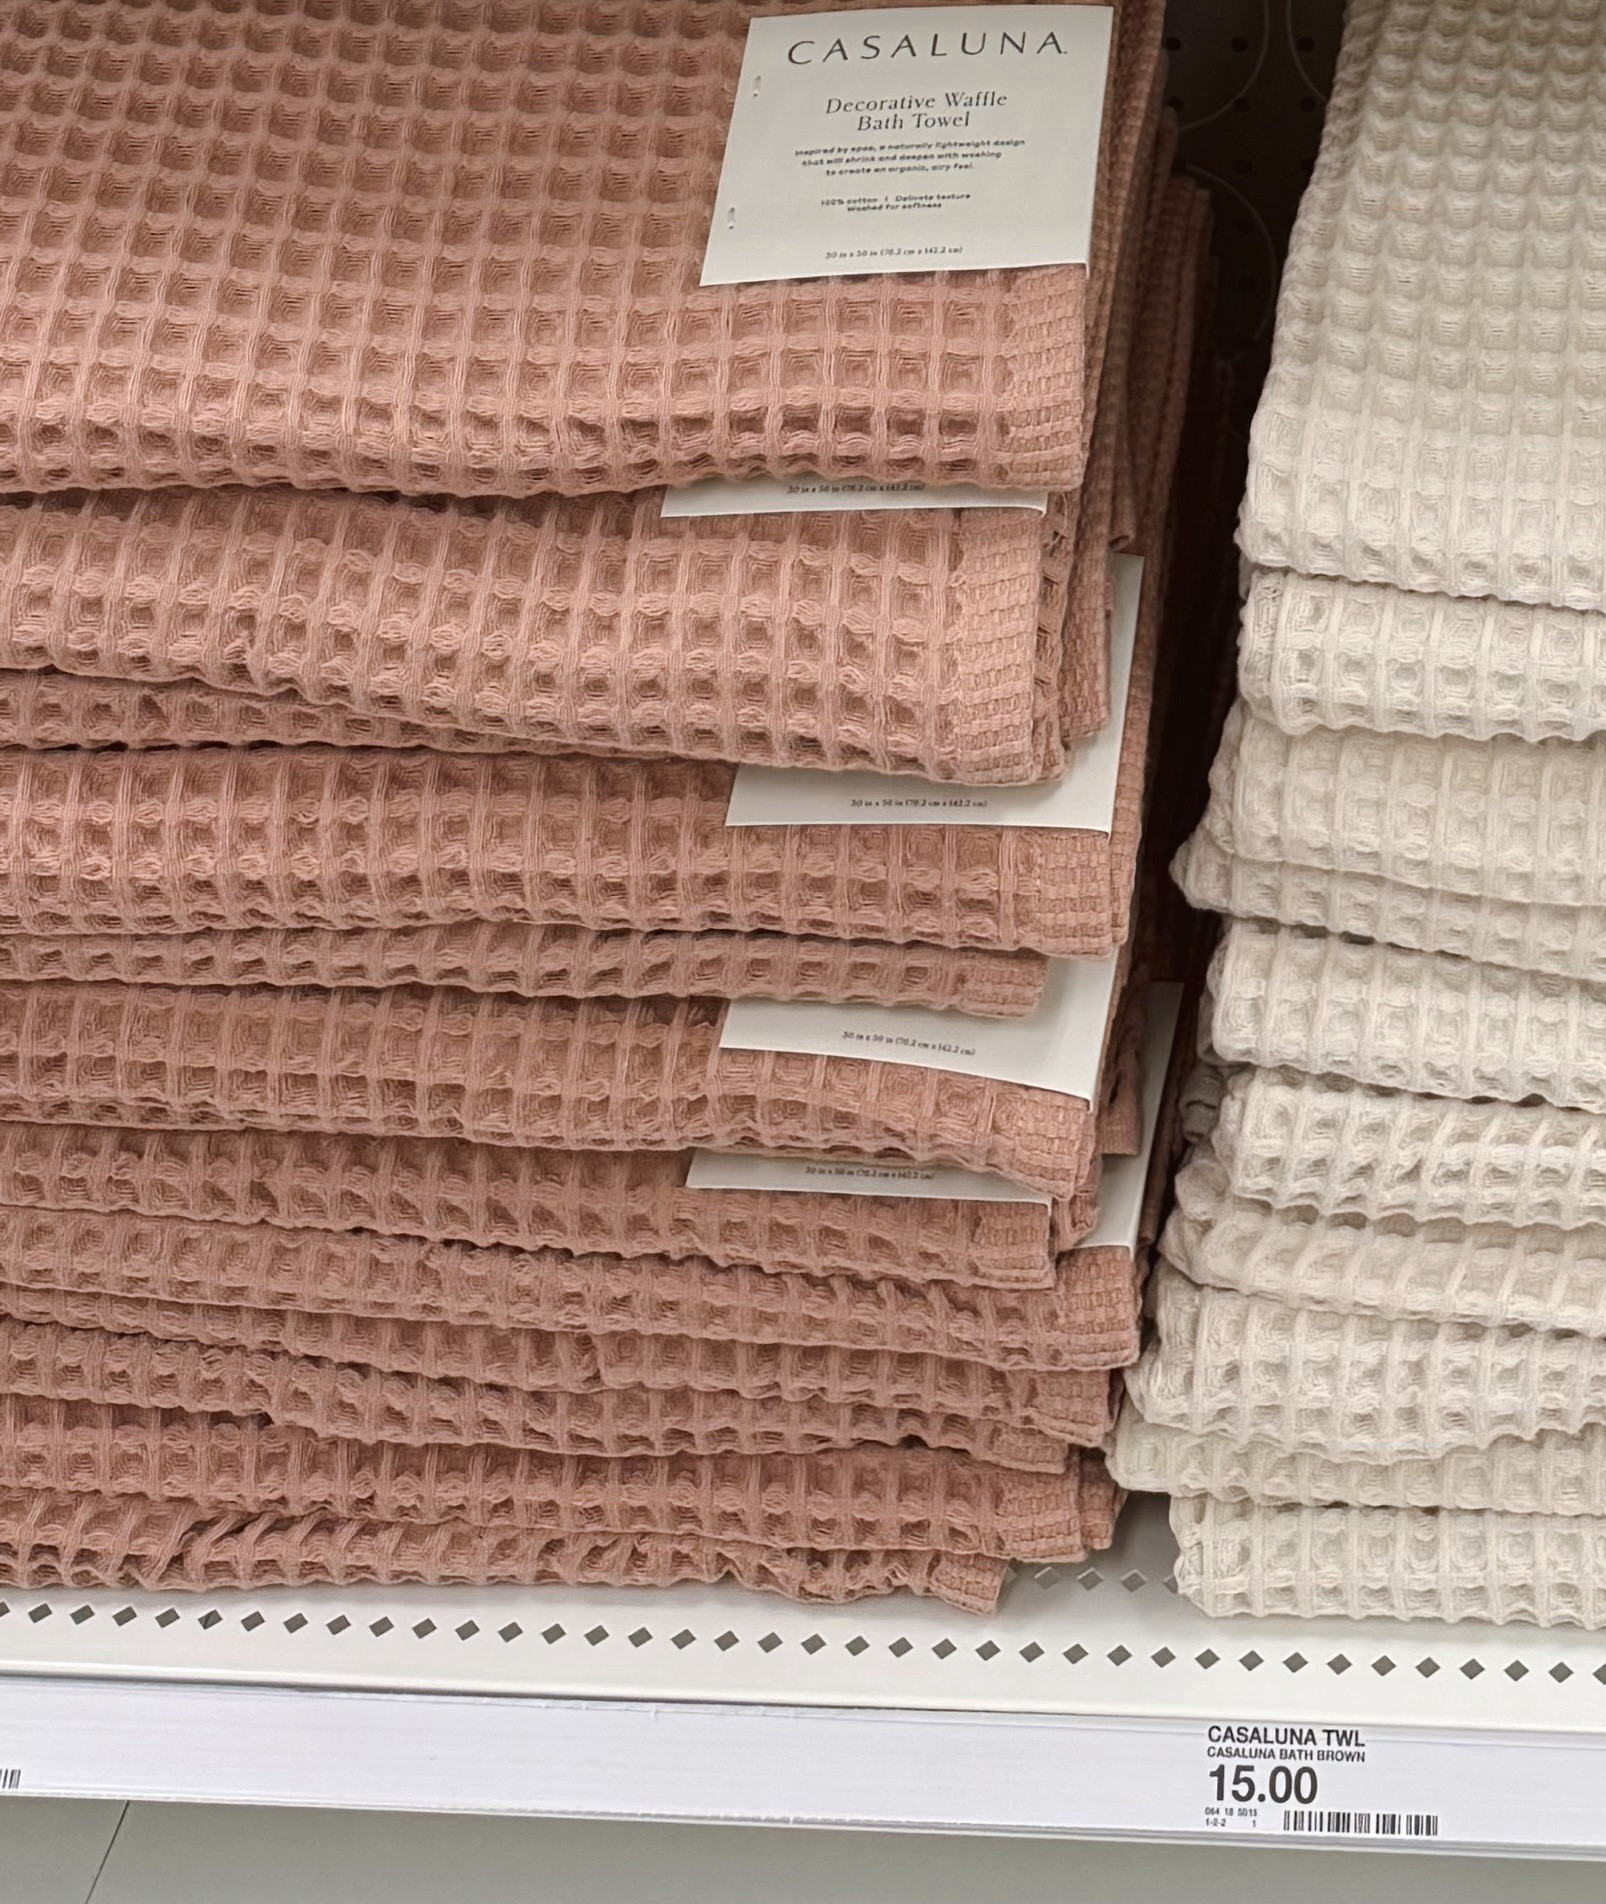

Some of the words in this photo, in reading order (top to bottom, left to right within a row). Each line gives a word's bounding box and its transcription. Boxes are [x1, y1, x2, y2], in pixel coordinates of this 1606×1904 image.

[788, 31, 1064, 65] CASALUNA
[825, 94, 936, 115] Decorative
[945, 91, 1008, 108] Waffle
[857, 113, 904, 131] Bath
[912, 111, 970, 129] Towel
[1208, 1725, 1317, 1746] CASALUNA
[1322, 1729, 1366, 1747] TWL
[1207, 1746, 1276, 1760] CASALUNA
[1279, 1748, 1313, 1761] BATH
[1317, 1750, 1366, 1763] BROWN
[1209, 1763, 1318, 1805] 15.00
